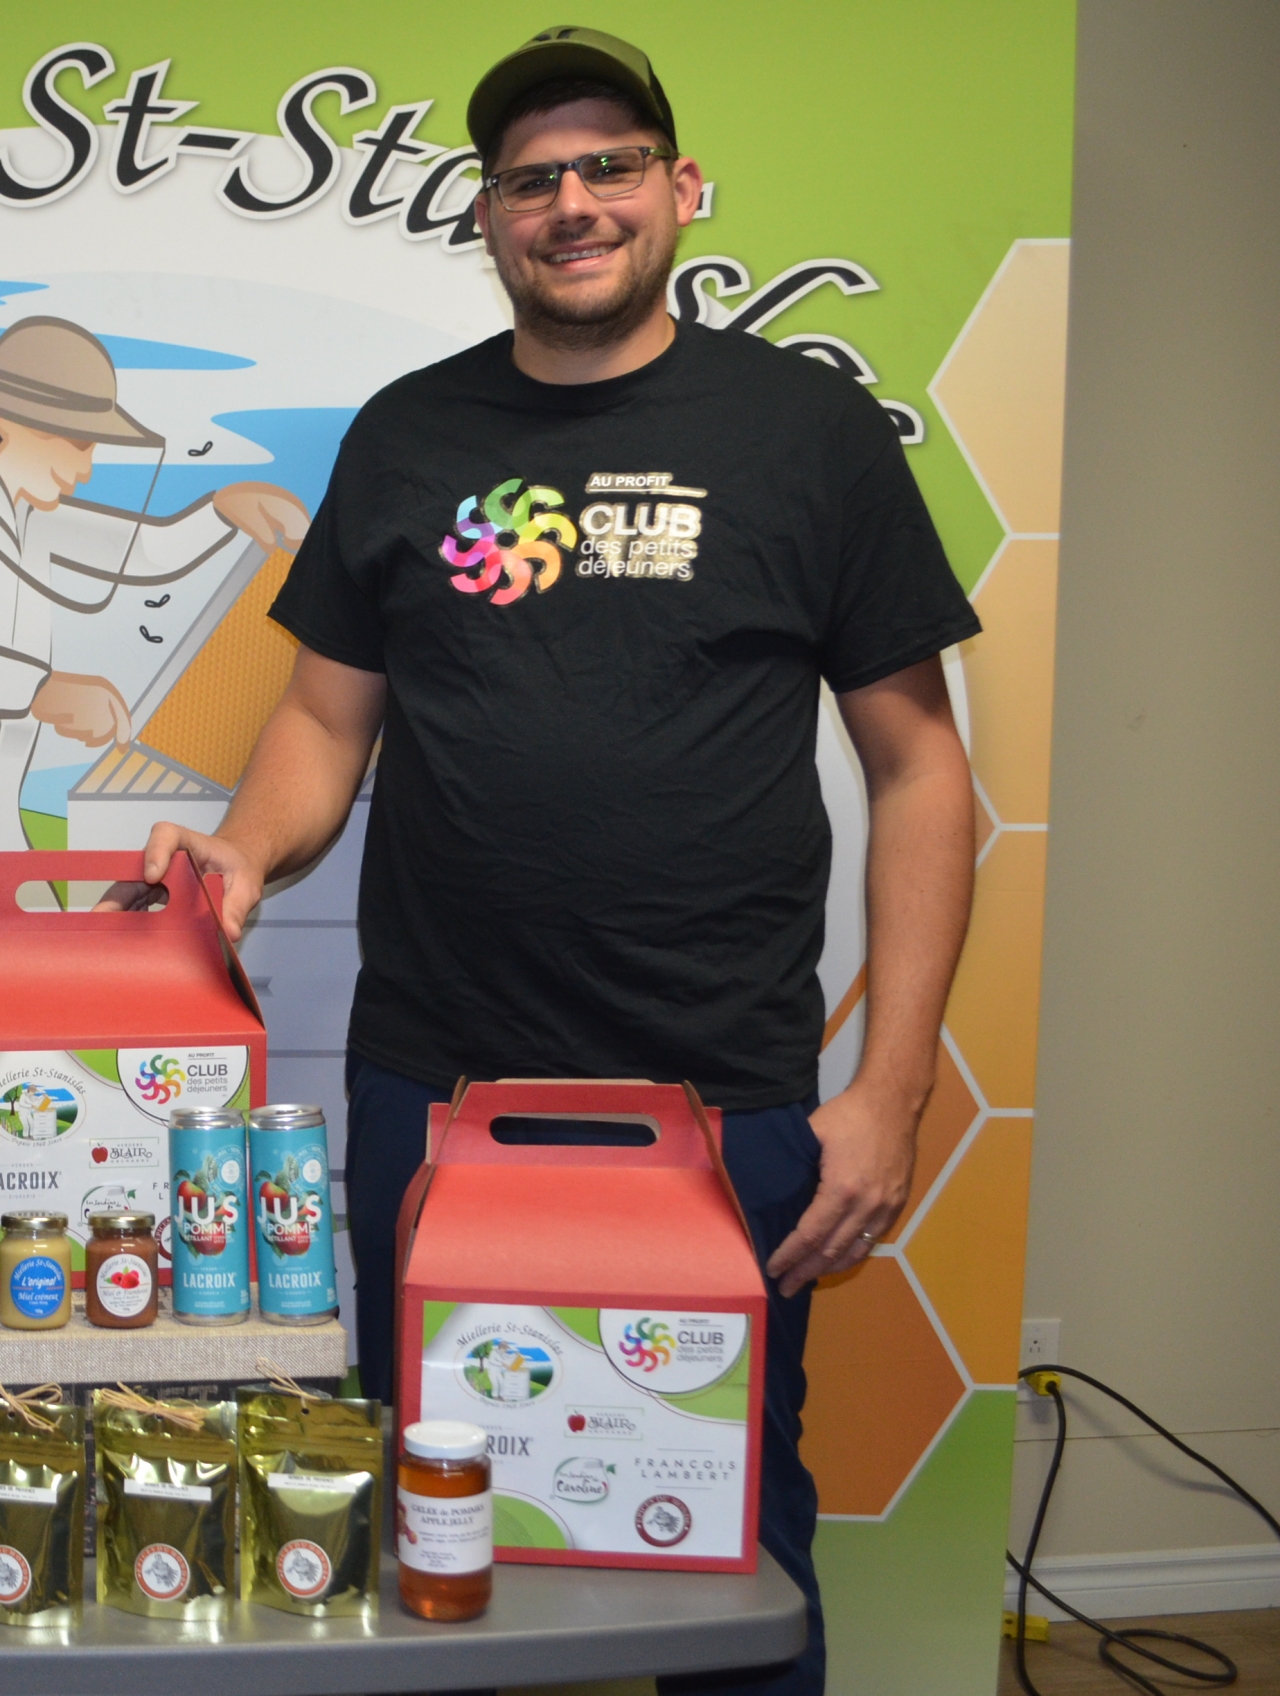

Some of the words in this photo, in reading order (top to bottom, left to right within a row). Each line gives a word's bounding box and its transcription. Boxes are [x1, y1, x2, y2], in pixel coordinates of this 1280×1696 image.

[590, 476, 611, 487] AU
[615, 476, 670, 488] PROFIT
[582, 505, 699, 538] CLUB
[580, 537, 622, 555] des
[628, 539, 695, 559] petits
[578, 557, 692, 579] déjeuners
[187, 1064, 228, 1077] CLUB
[33, 1067, 86, 1095] St-Stanislas
[187, 1077, 202, 1085] des
[204, 1077, 228, 1086] petits
[186, 1084, 228, 1094] déjeuners
[110, 1148, 153, 1160] BLAIR
[174, 1195, 239, 1225] JUS
[256, 1194, 322, 1225] JUS
[184, 1222, 232, 1235] POMME
[267, 1223, 315, 1235] POMME
[22, 1276, 56, 1290] L'original
[184, 1272, 236, 1289] LACROIX
[269, 1271, 322, 1289] LACROIX
[18, 1292, 34, 1300] Miel
[456, 1322, 502, 1349] Miellerie
[677, 1330, 724, 1345] CLUB
[588, 1416, 636, 1430] BLAIR
[486, 1435, 530, 1456] ROIX
[641, 1470, 729, 1480] LAMBERT
[420, 1516, 446, 1526] APPLE
[448, 1516, 474, 1527] JELLY
